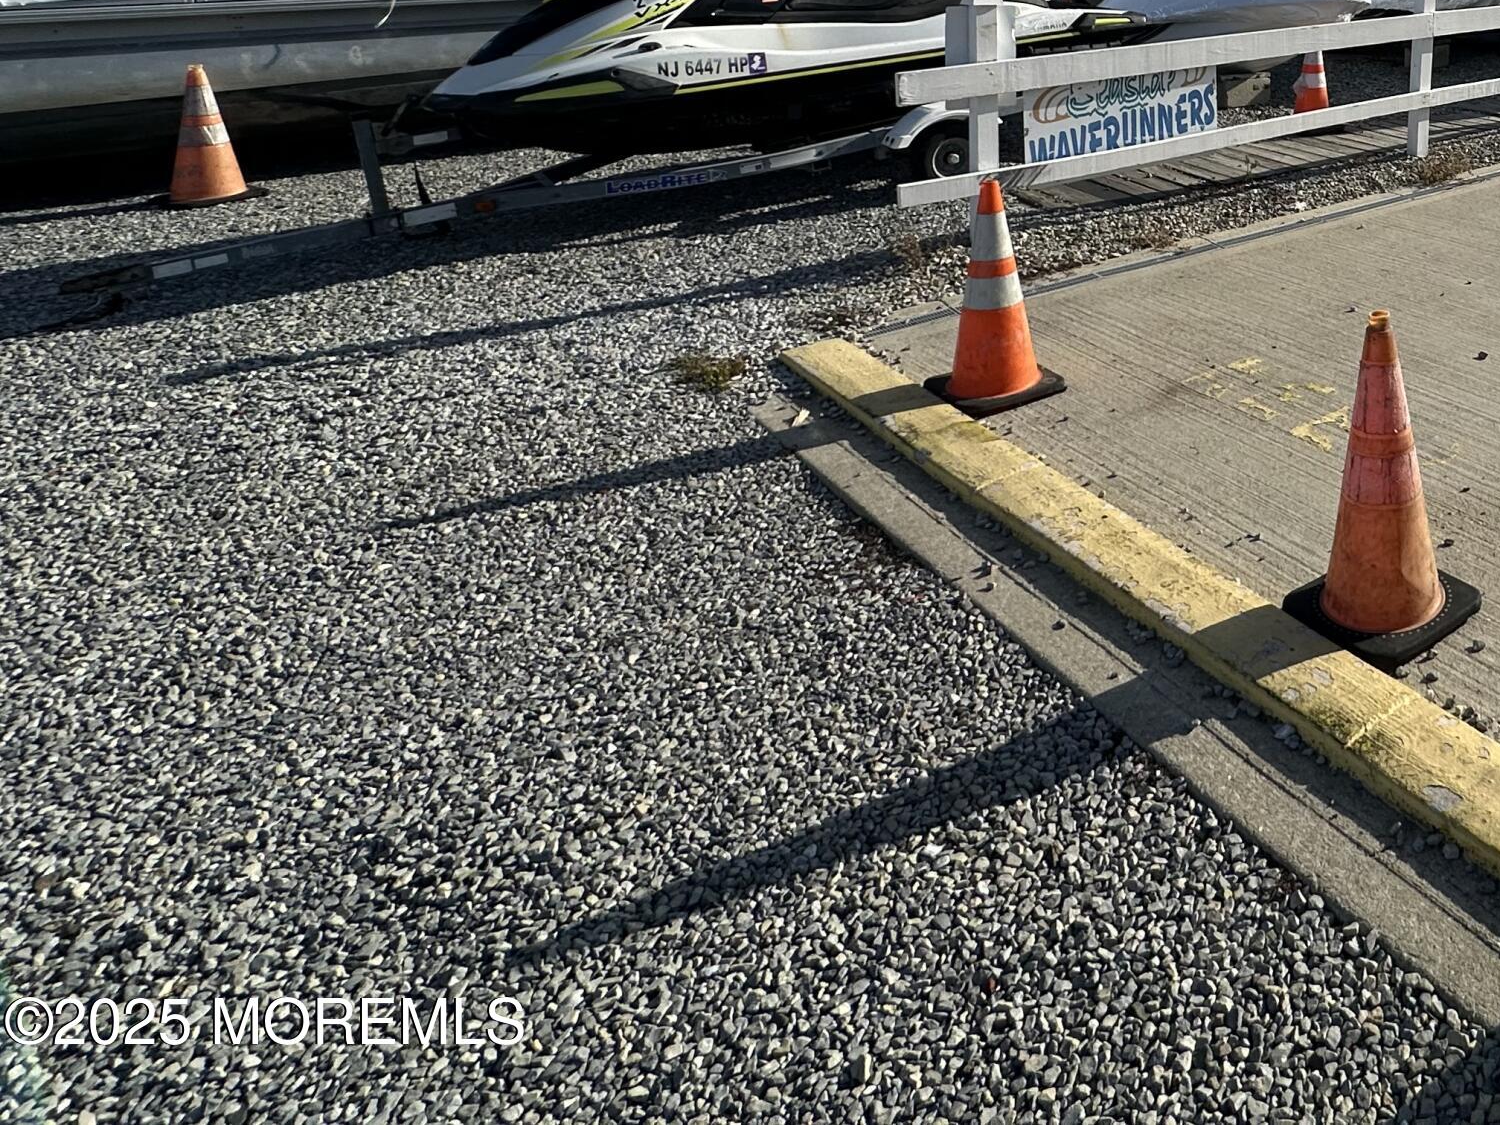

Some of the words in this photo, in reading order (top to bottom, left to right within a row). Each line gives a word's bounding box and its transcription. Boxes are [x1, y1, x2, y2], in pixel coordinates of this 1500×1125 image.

[657, 62, 679, 78] NJ
[685, 59, 722, 76] 6447
[728, 57, 748, 74] HP
[1029, 83, 1216, 163] WAVERUNNERS
